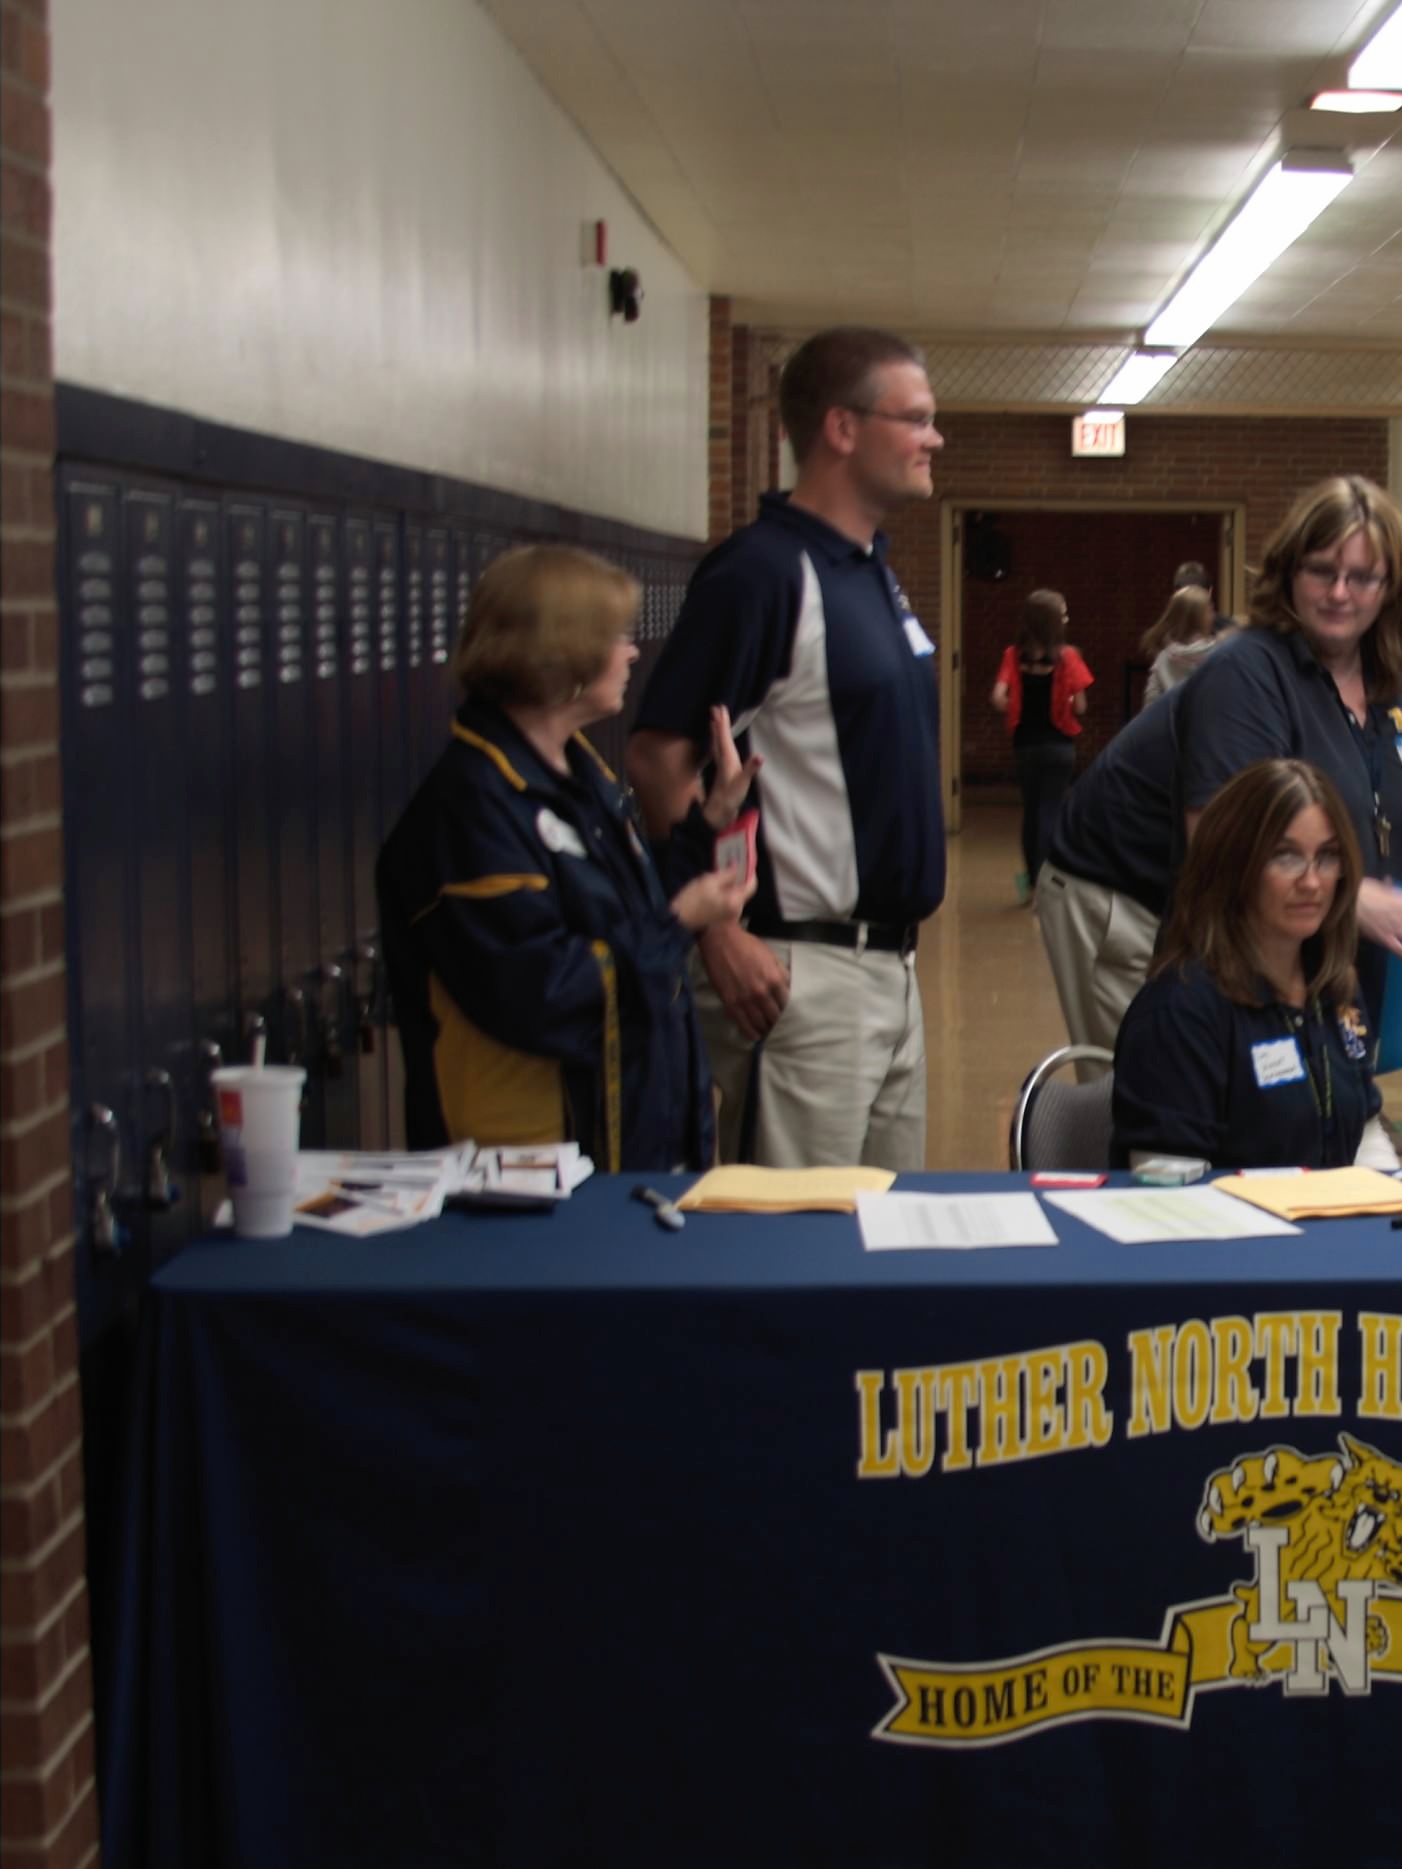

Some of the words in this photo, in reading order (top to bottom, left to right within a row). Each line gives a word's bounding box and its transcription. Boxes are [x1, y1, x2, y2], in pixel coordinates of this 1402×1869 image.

[1080, 422, 1119, 449] EXIT
[856, 1339, 1114, 1479] LUTHER
[1127, 1311, 1343, 1439] NORTH
[1249, 1527, 1371, 1696] LN
[918, 1669, 1049, 1729] HOME
[1063, 1665, 1100, 1697] OF
[1111, 1664, 1175, 1702] THE
